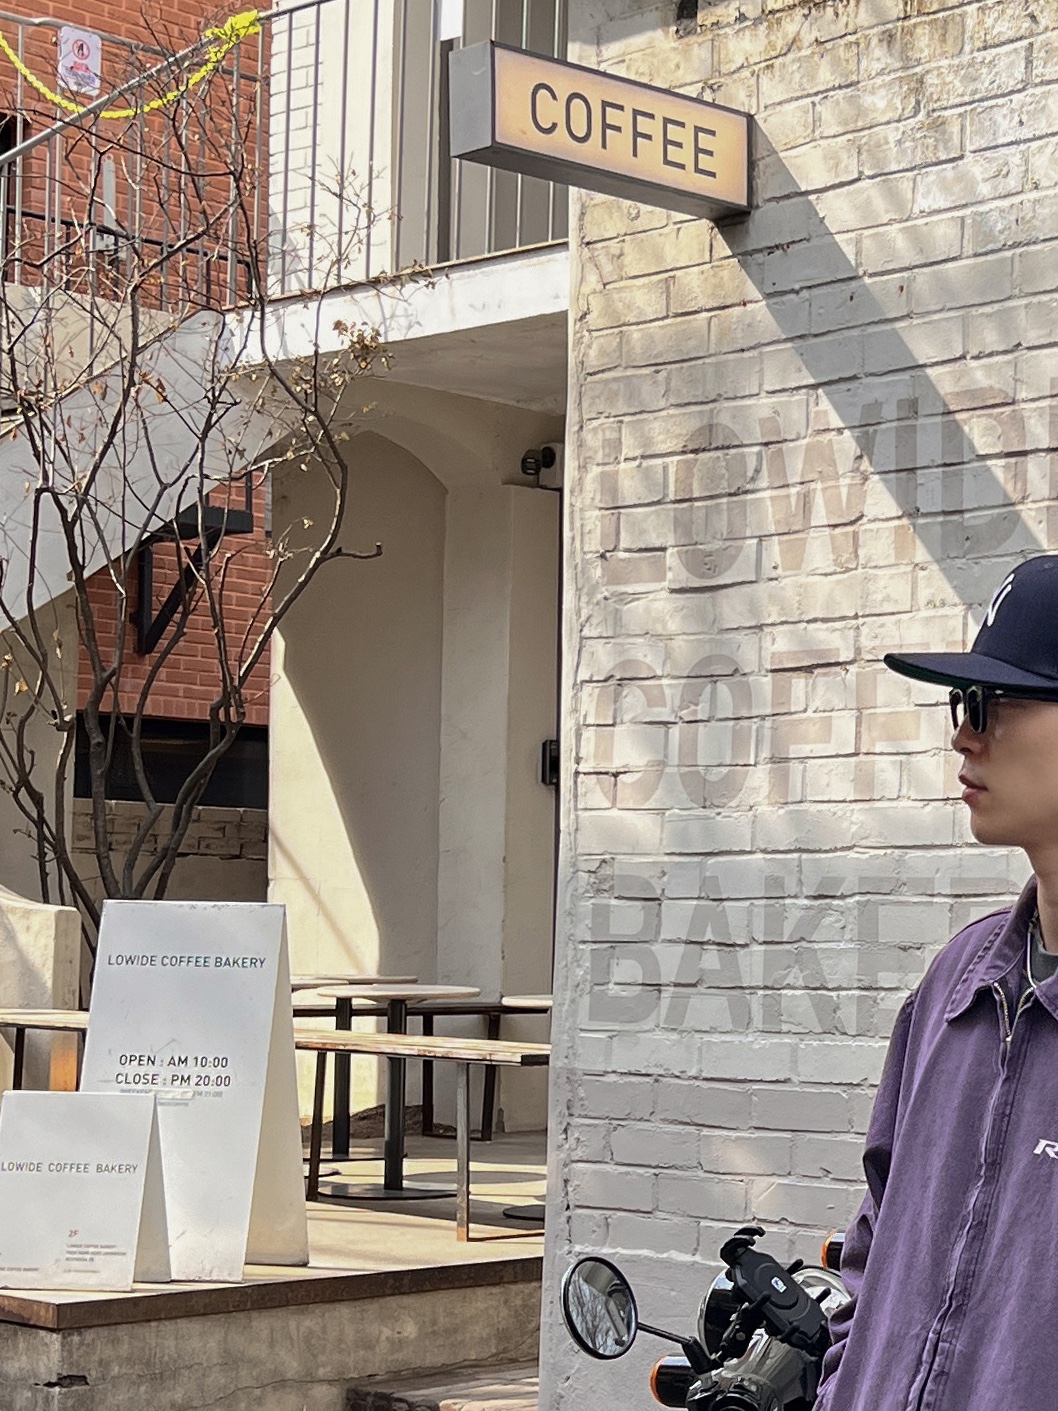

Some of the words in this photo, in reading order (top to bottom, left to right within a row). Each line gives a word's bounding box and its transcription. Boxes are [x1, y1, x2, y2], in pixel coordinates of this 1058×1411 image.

[531, 82, 717, 179] COFFEE
[596, 648, 964, 808] COFF
[107, 954, 158, 967] LOWIDE
[161, 955, 211, 968] COFFEE
[214, 956, 267, 969] BAKERY
[584, 876, 1024, 1034] BAKE
[119, 1054, 156, 1067] OPEN
[167, 1055, 188, 1067] AM
[193, 1056, 229, 1068] 10:00
[115, 1072, 160, 1086] CLOSE
[171, 1074, 191, 1086] PM
[194, 1075, 231, 1087] 20:00
[0, 1161, 43, 1173] LOWIDE
[48, 1162, 90, 1174] COFFEE
[96, 1163, 138, 1174] BAKERY
